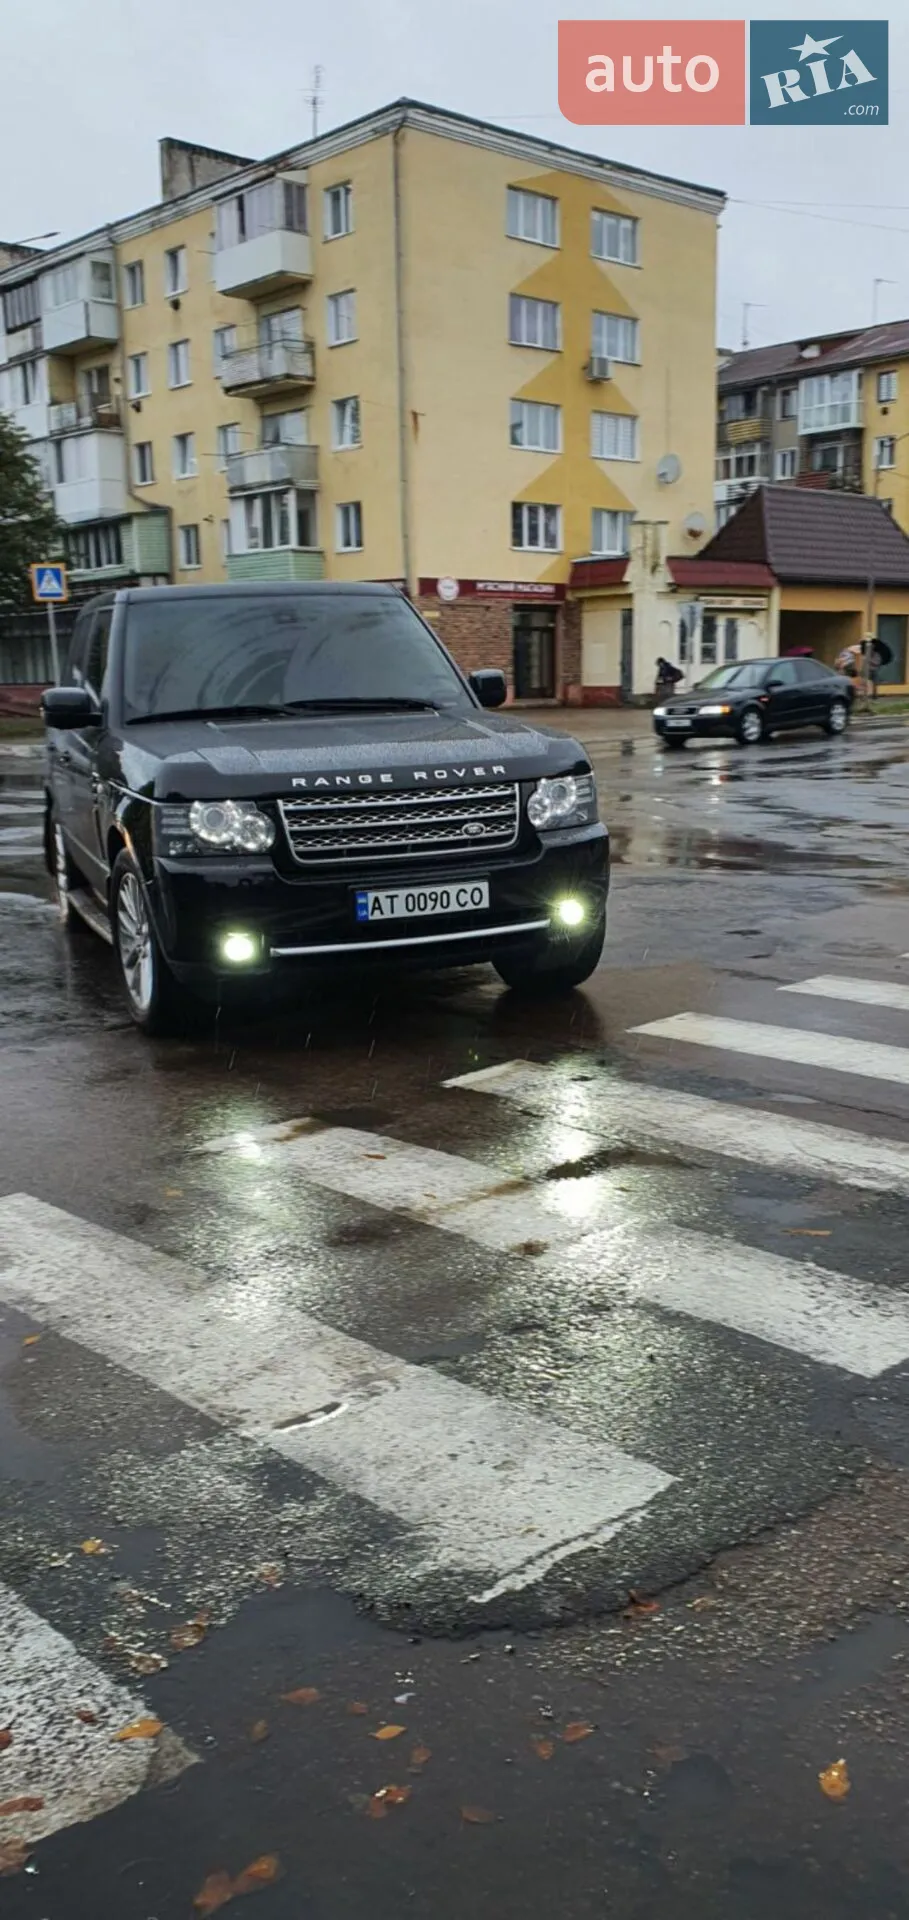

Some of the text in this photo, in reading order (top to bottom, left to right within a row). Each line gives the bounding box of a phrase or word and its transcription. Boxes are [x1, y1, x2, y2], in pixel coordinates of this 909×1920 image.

[291, 765, 506, 787] RANGE ROVER
[370, 887, 484, 916] AT 0090 CO
